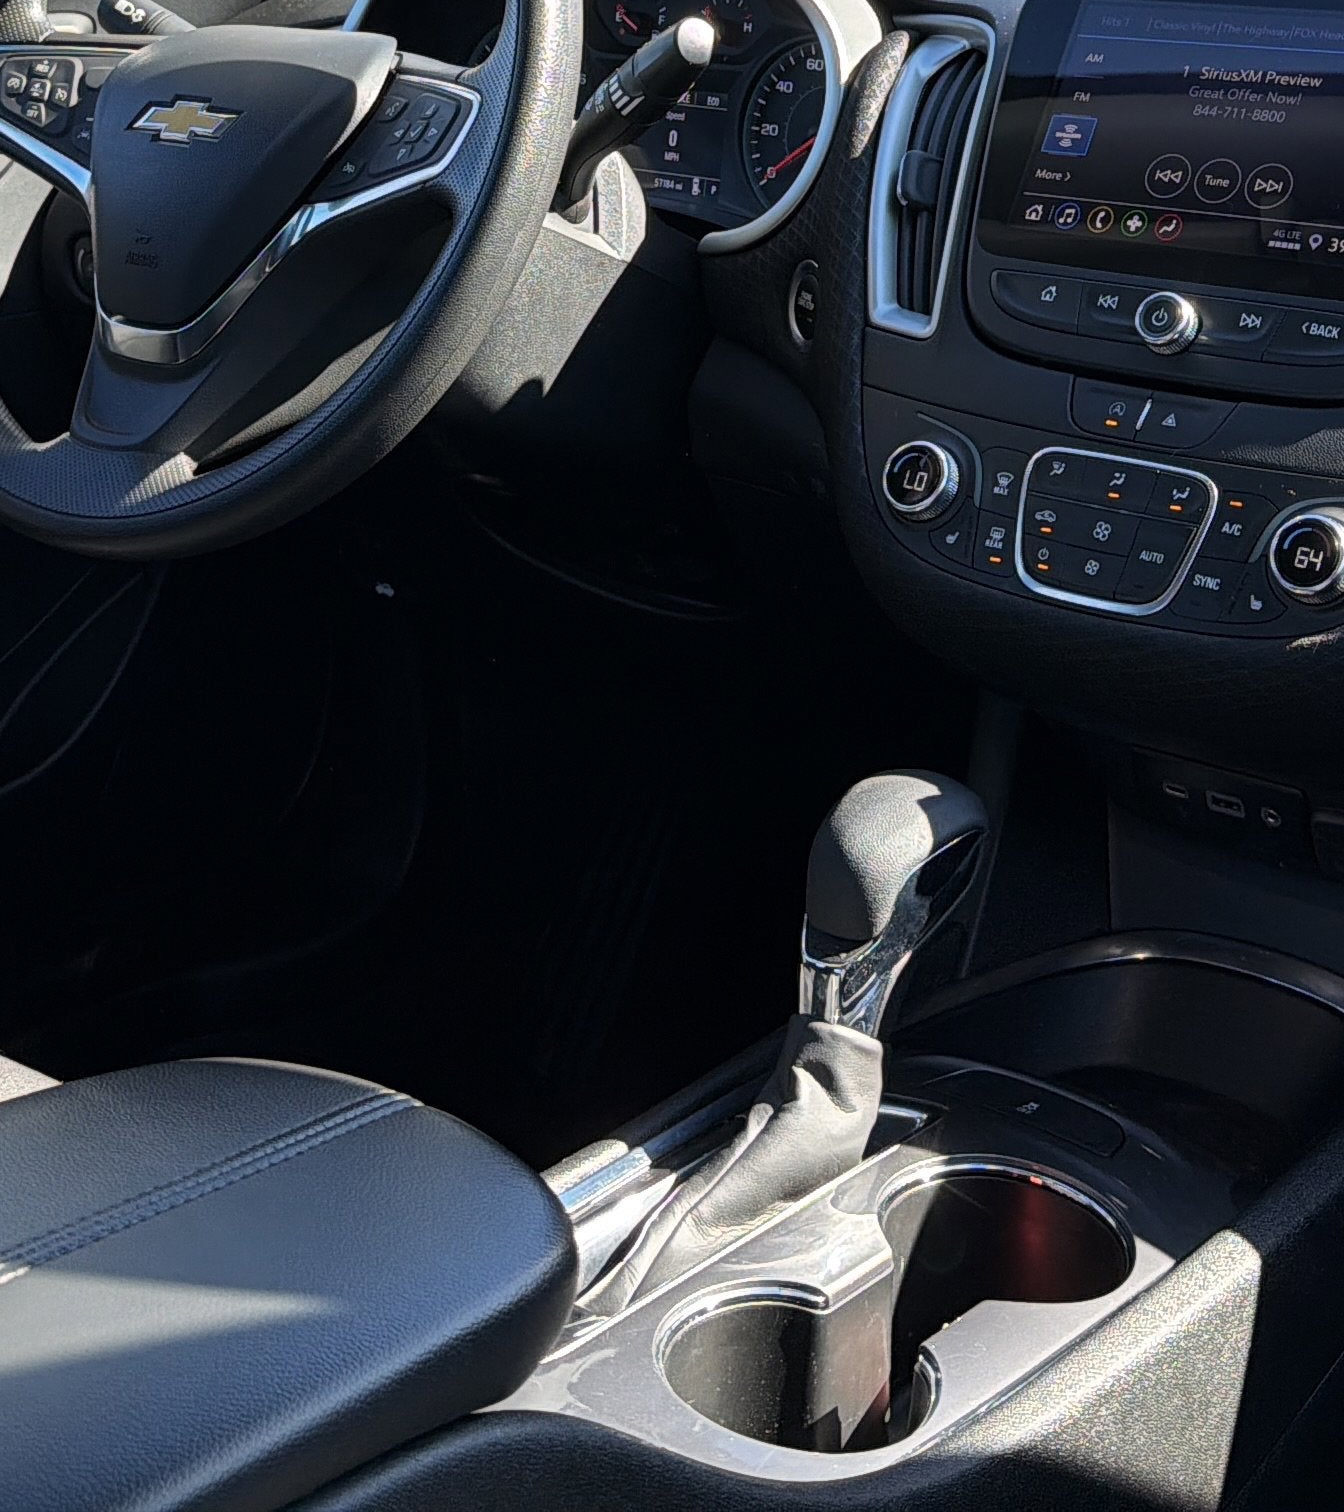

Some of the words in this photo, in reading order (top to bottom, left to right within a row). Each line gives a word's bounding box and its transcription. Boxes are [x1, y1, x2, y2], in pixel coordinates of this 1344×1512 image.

[615, 11, 623, 22] E
[658, 14, 665, 25] F
[743, 23, 752, 33] H
[1244, 24, 1290, 39] Highway
[1293, 27, 1317, 38] FOX
[1085, 53, 1104, 63] AM
[805, 59, 824, 71] 60
[1183, 65, 1190, 78] 1
[1199, 66, 1263, 83] SiriusXM
[1265, 73, 1323, 88] Preview
[775, 81, 794, 93] 40
[1073, 91, 1091, 102] FM
[1188, 86, 1224, 100] Great
[1228, 88, 1264, 102] Offer
[1267, 92, 1302, 106] Now!
[665, 110, 686, 123] Speed
[1192, 104, 1286, 123] 844-711-8800
[761, 124, 779, 136] 20
[668, 129, 678, 147] 0
[664, 151, 680, 163] MPH
[1035, 169, 1062, 181] More
[1204, 175, 1230, 187] Tune
[710, 185, 717, 195] P
[1272, 229, 1286, 238] 4G
[1287, 231, 1301, 240] LTE
[1309, 322, 1341, 339] BACK
[993, 486, 1009, 496] MAX
[1221, 521, 1243, 536] A/C
[985, 538, 1003, 549] REAR
[1138, 549, 1165, 564] AUTO
[1294, 546, 1323, 572] 64
[1193, 573, 1221, 591] SYNC
